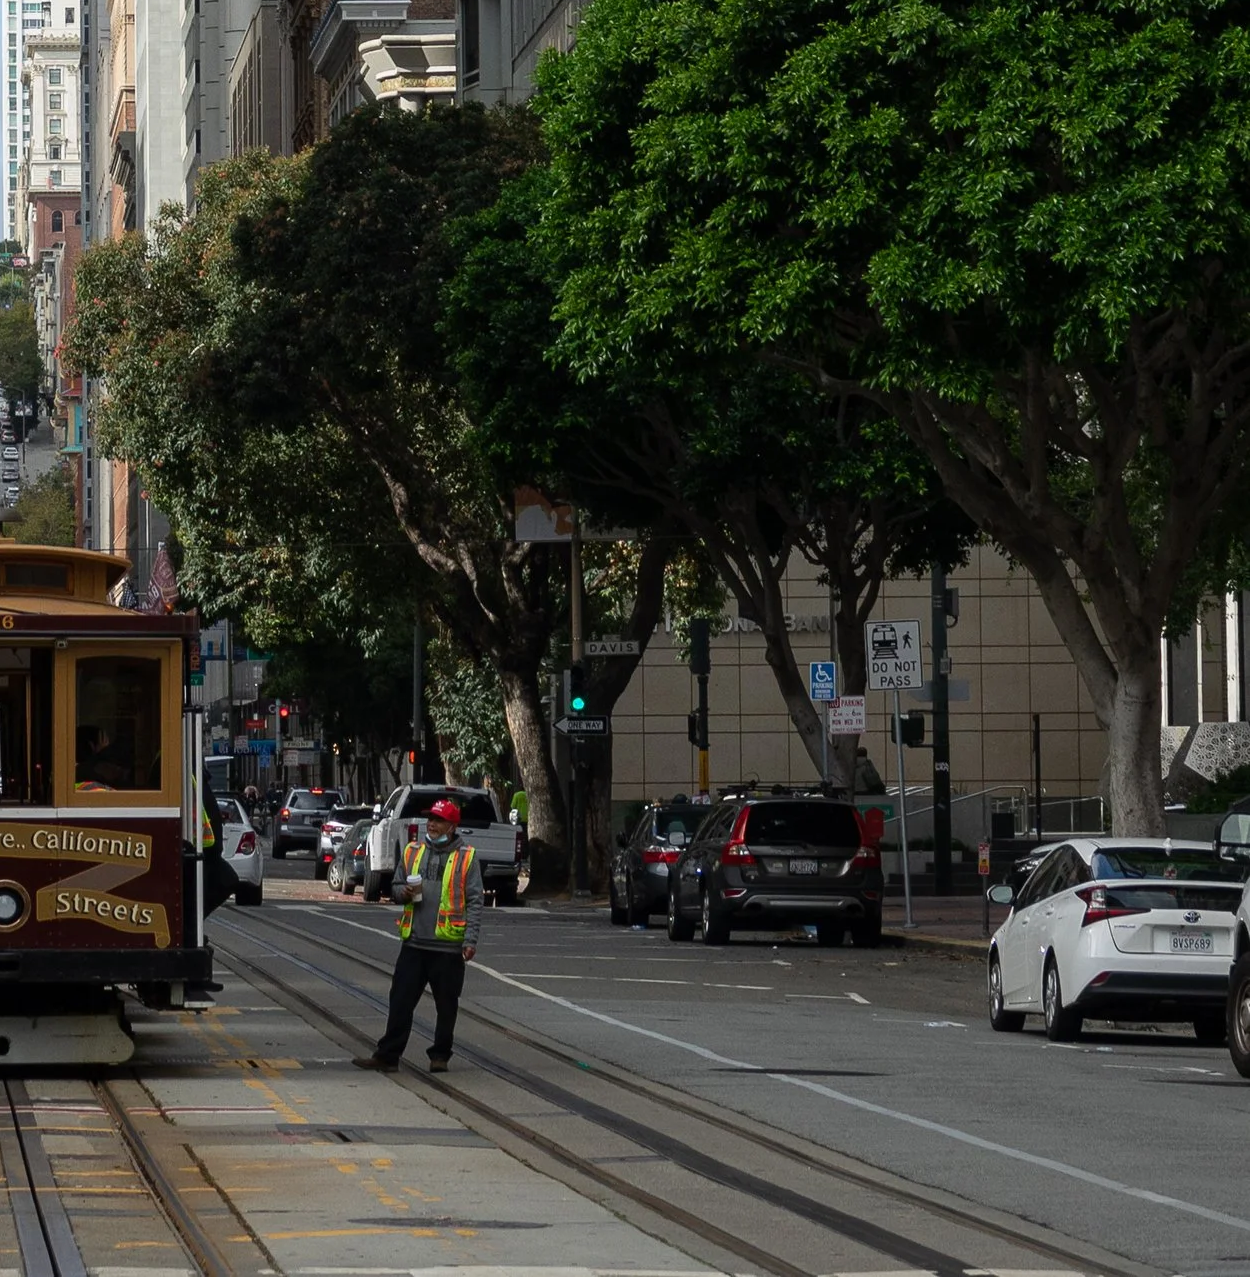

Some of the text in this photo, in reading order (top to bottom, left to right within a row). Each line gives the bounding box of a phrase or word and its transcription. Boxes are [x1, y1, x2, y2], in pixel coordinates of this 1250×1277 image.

[784, 613, 830, 633] BAN
[590, 643, 634, 653] DAVIS
[872, 661, 917, 673] DO NOT
[880, 676, 911, 687] PASS
[841, 699, 863, 707] PARKING
[568, 721, 601, 729] ONE WAY
[32, 829, 148, 859] California
[56, 893, 154, 925] Streets
[1172, 938, 1211, 949] 8VSP689
